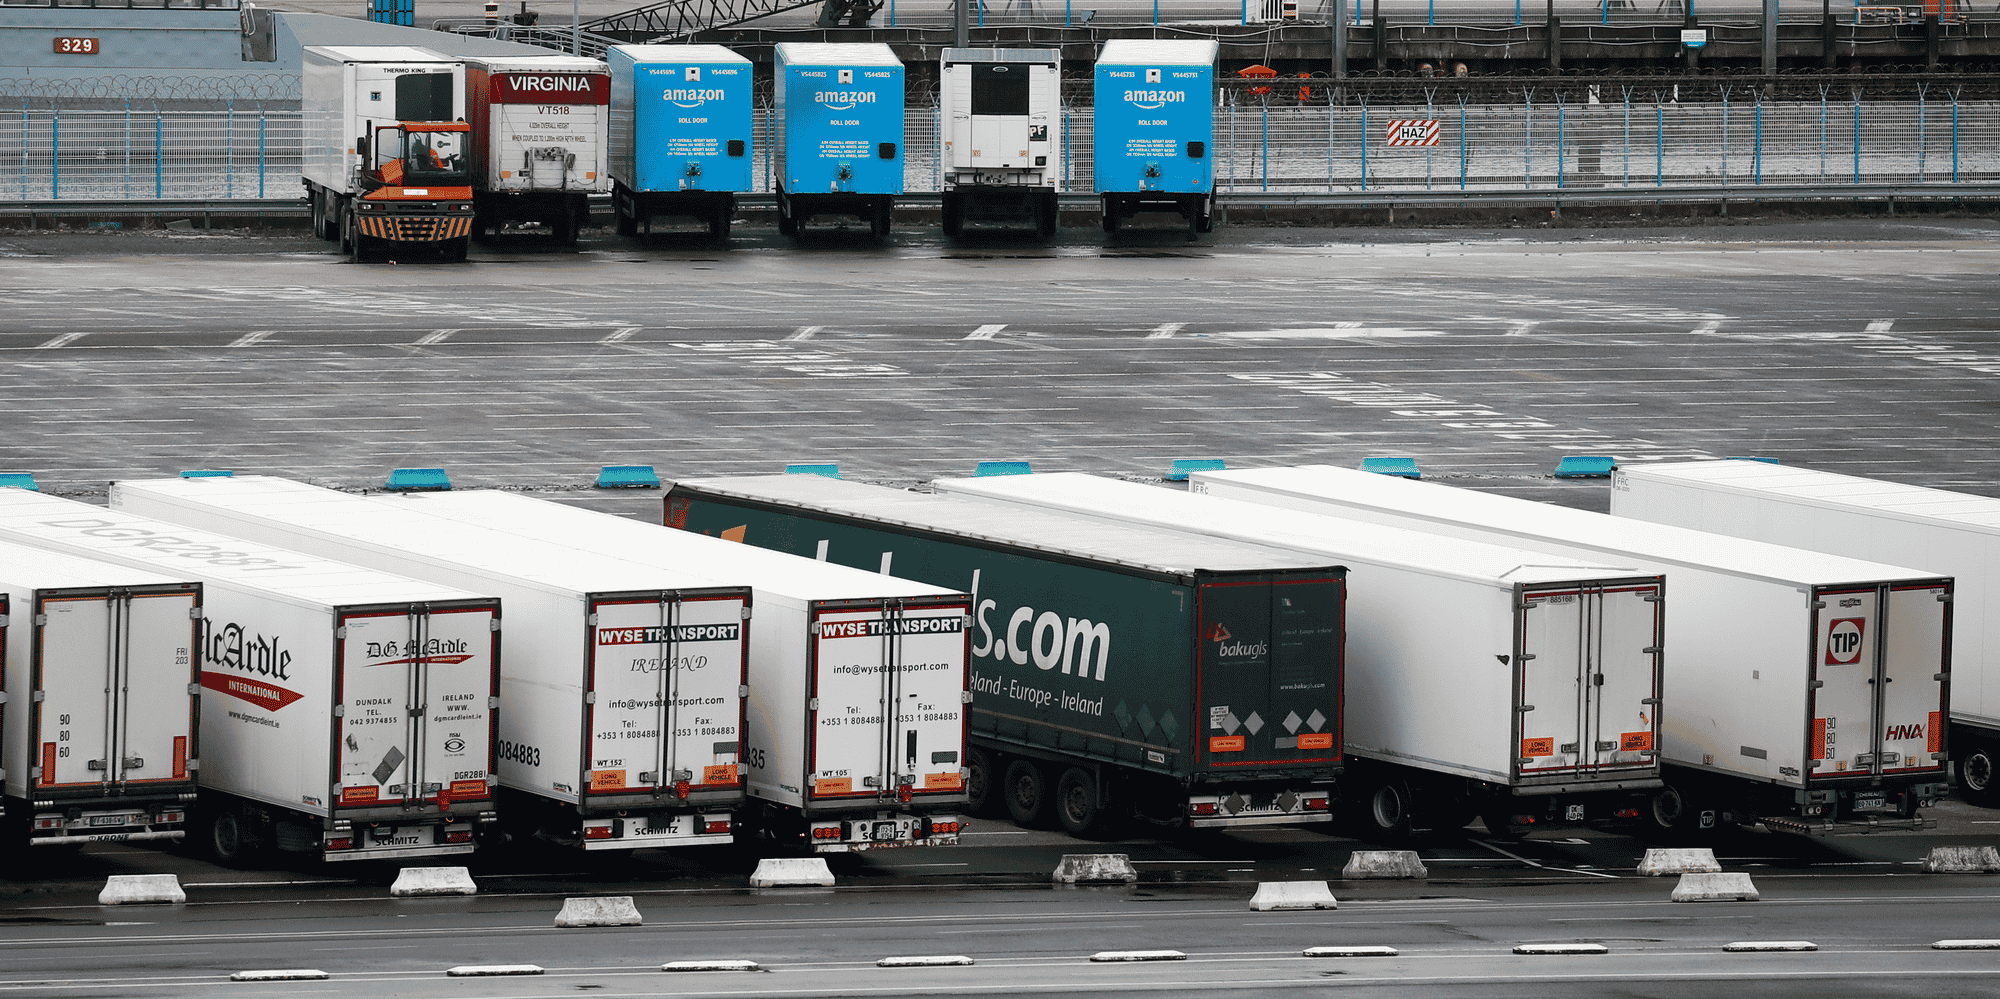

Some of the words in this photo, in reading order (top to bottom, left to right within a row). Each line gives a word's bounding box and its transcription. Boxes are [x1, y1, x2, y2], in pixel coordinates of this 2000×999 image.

[62, 38, 92, 52] 329
[509, 76, 591, 91] VIRGINIA
[663, 89, 725, 101] amazon
[814, 91, 877, 103] amazon
[1124, 90, 1186, 102] amazon
[1402, 128, 1425, 138] HAZ
[823, 622, 866, 637] WYSE
[868, 619, 961, 634] TRANSPORT
[600, 629, 644, 643] WYSE
[645, 626, 738, 641] TRANSPORT
[1832, 632, 1859, 653] TIP
[176, 648, 188, 656] FRI
[1220, 640, 1267, 660] bakugls
[175, 656, 188, 665] 203
[630, 654, 708, 673] IRELAND
[833, 663, 949, 675] info@wysetransport.com
[228, 680, 281, 701] INTERNATIONAL
[355, 698, 392, 706] DUNDALK
[442, 693, 475, 702] IRELAND
[1009, 679, 1052, 708] Europe
[1061, 690, 1104, 716] Ireland
[447, 704, 470, 712] WWW.
[608, 697, 725, 710] info@wysetransport.com
[917, 702, 936, 711] Fax:
[846, 706, 861, 714] Tel:
[59, 714, 70, 725] 90
[365, 717, 397, 725] 9374855
[695, 717, 713, 725] Fax:
[821, 718, 841, 726] +353
[924, 712, 958, 721] 8084883
[622, 720, 637, 728] Tel:
[1826, 717, 1836, 729] 90
[59, 730, 70, 742] 80
[597, 731, 617, 739] +353
[701, 727, 735, 736] 8084883
[1826, 732, 1835, 744] 80
[59, 747, 70, 757] 60
[1825, 748, 1835, 759] 60
[634, 826, 678, 836] SCHMITZ
[96, 833, 130, 842] KRONE
[375, 836, 419, 847] SCHMITZ
